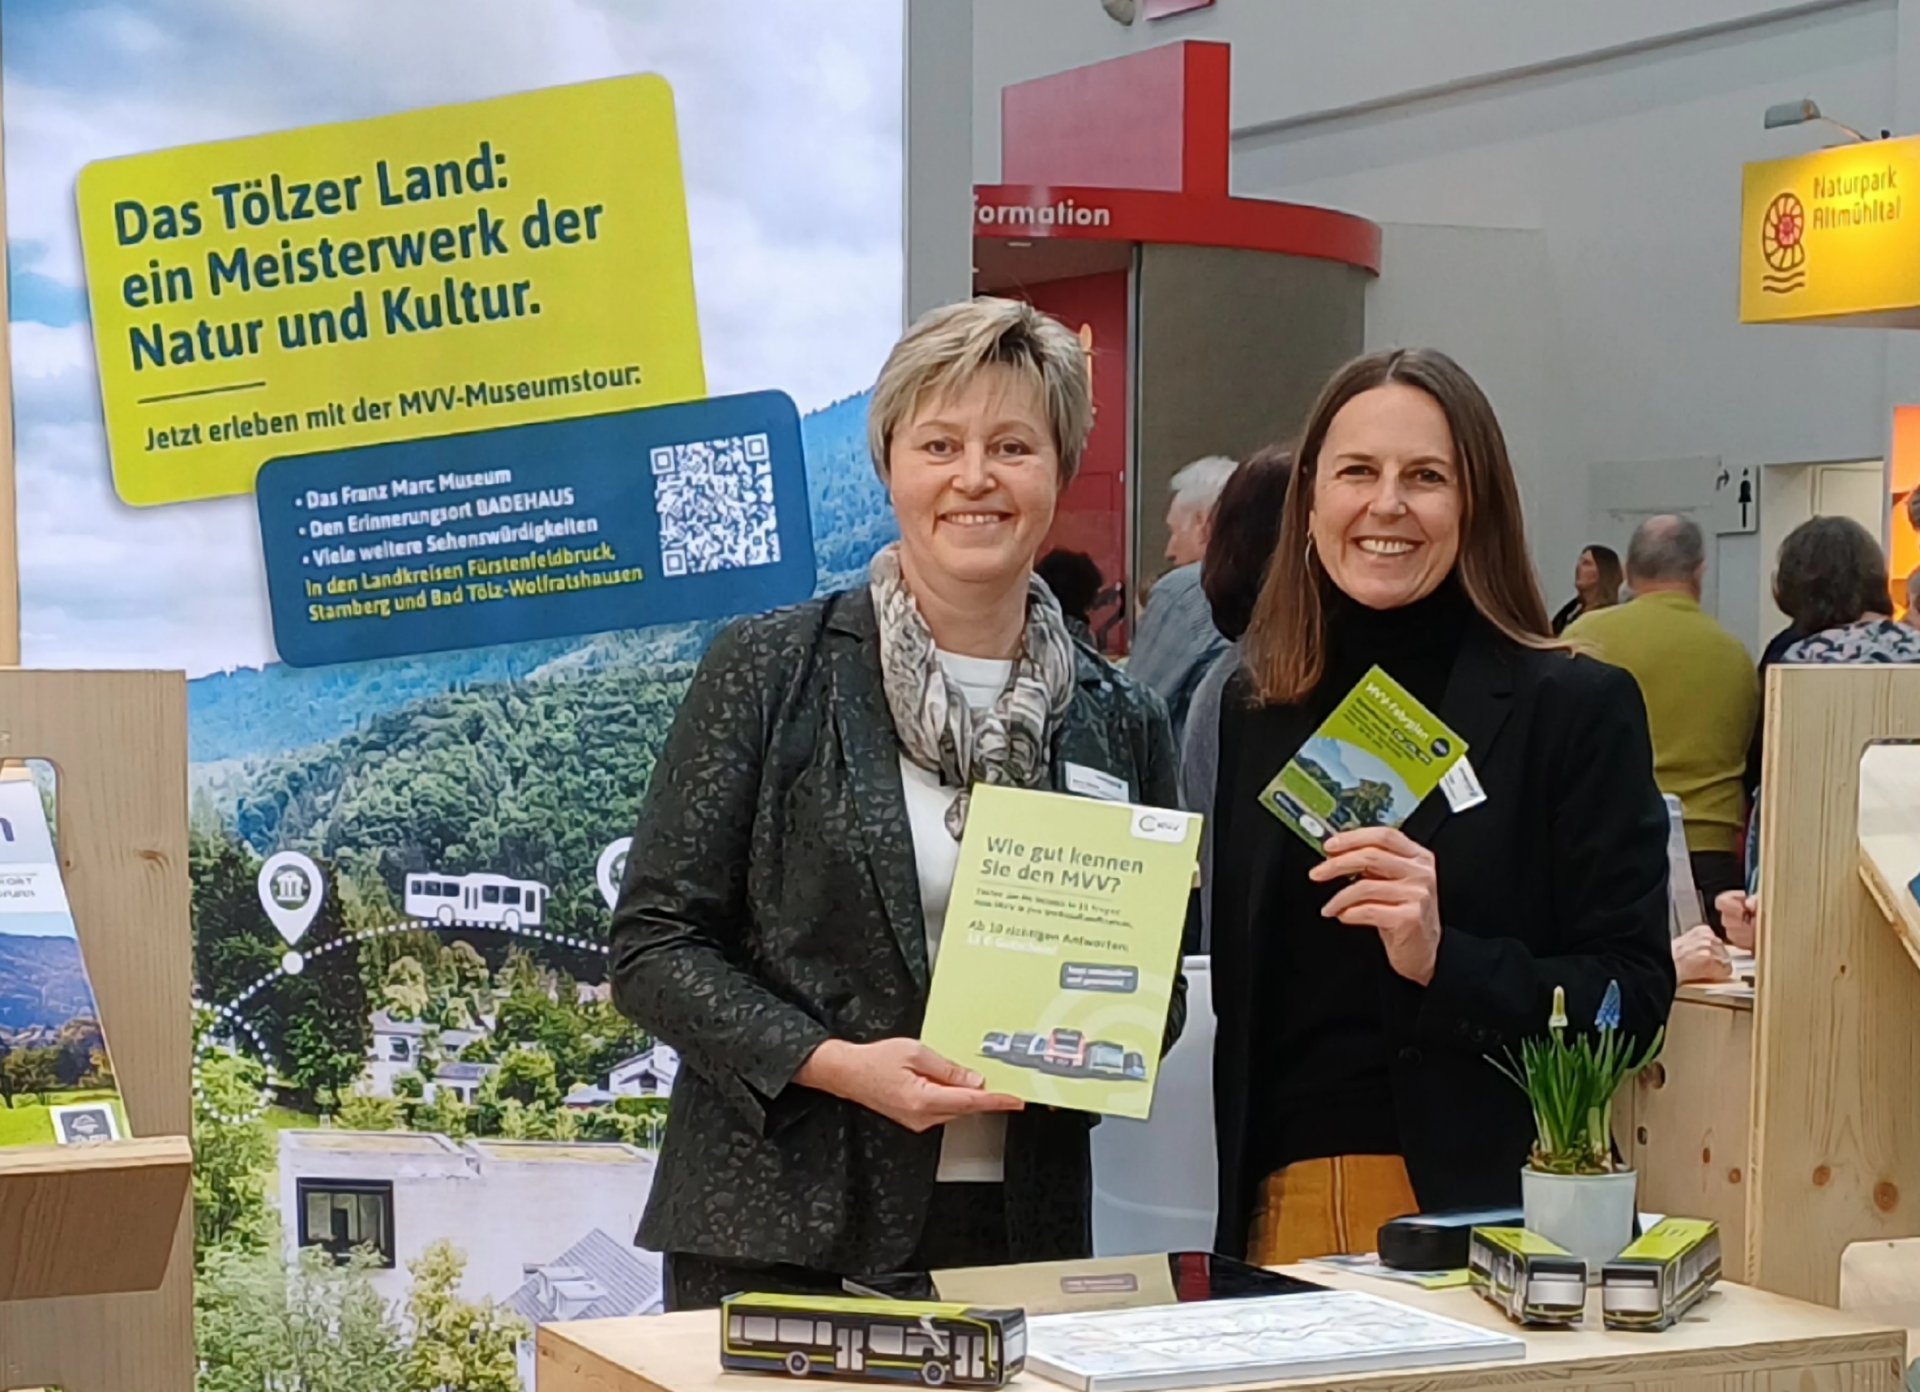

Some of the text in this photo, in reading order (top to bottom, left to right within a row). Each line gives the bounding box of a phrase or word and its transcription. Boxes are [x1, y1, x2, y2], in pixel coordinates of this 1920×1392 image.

[114, 141, 508, 246] Das Tölzer Land:
[1814, 165, 1896, 198] Naturpark
[1814, 196, 1902, 229] Altmühltal
[122, 198, 603, 308] ein Meisterwerk der
[130, 278, 541, 371] Natur und Kultur.
[145, 366, 641, 451] Jetzt erleben mit der MVV-Museumstour.
[306, 469, 512, 509] Das Franz Marc Museum
[310, 487, 574, 538] Den Erinnerungsort BADEHAUS
[312, 518, 598, 567] Viele weitere Sehenswürdigkeiten
[327, 575, 357, 595] den
[361, 563, 463, 590] Landkreisen
[308, 597, 391, 622] Starnberg
[394, 590, 427, 611] und
[431, 586, 463, 606] Bad
[987, 836, 1143, 874] Wie gut kennen
[981, 859, 1121, 894] Sie den MVV?
